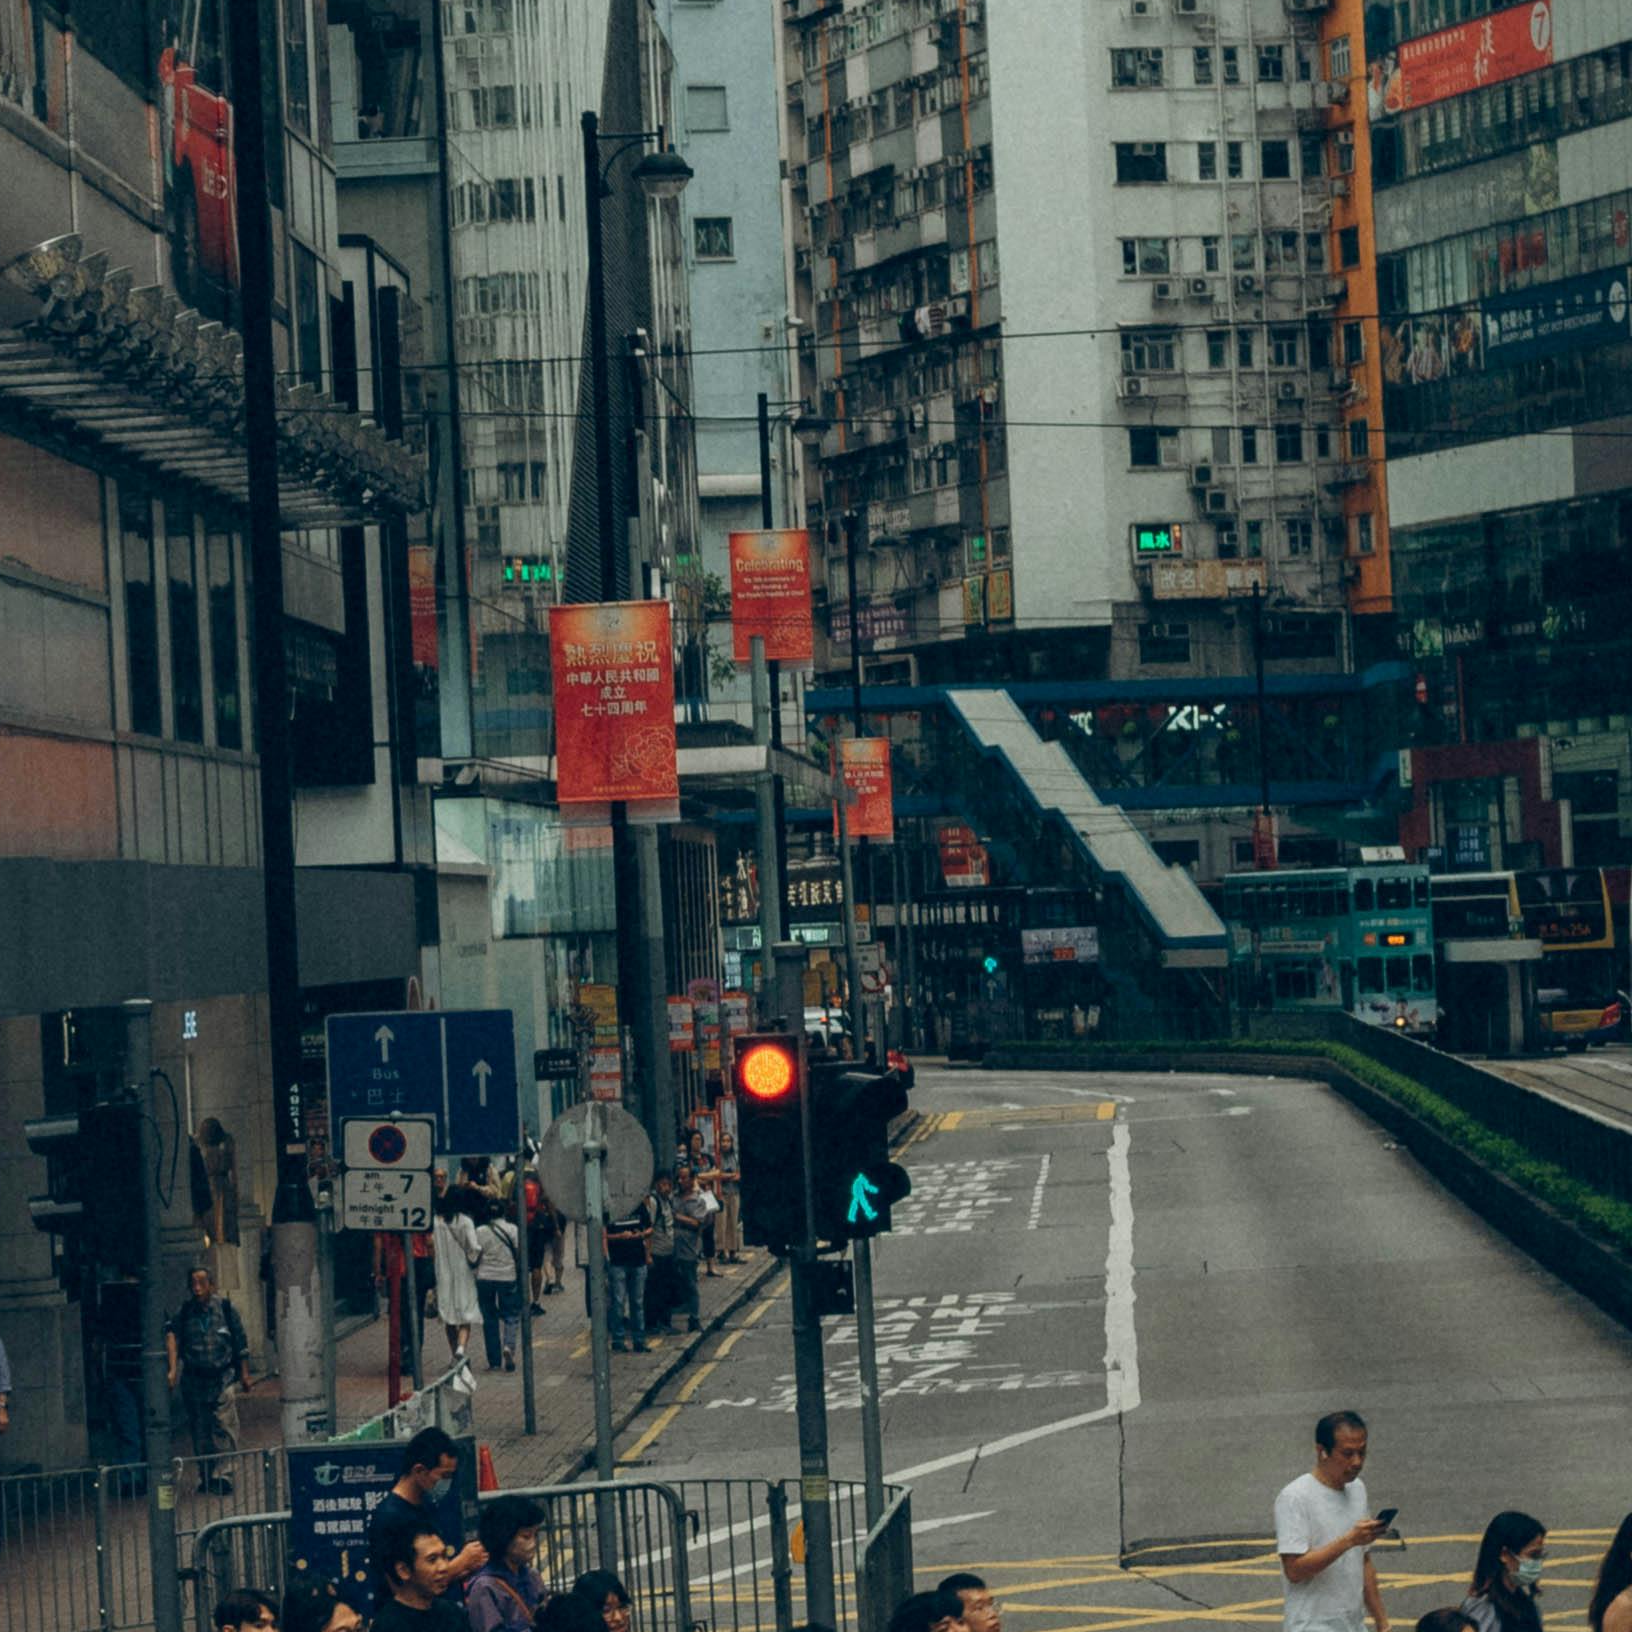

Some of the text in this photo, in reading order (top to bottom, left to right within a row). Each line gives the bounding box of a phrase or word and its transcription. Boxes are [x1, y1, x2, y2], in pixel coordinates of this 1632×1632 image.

[736, 558, 804, 574] Celebrating
[564, 640, 661, 667] 熱烈慶祝
[566, 668, 660, 686] 中華人民共和國
[600, 686, 627, 699] 成立
[581, 701, 648, 717] 七十四周年
[371, 1067, 400, 1081] Bus
[367, 1087, 406, 1106] 巴士
[359, 1181, 385, 1194] 上午
[364, 1171, 414, 1194] am 7
[349, 1203, 395, 1216] midnight
[359, 1207, 426, 1228] 午夜 12
